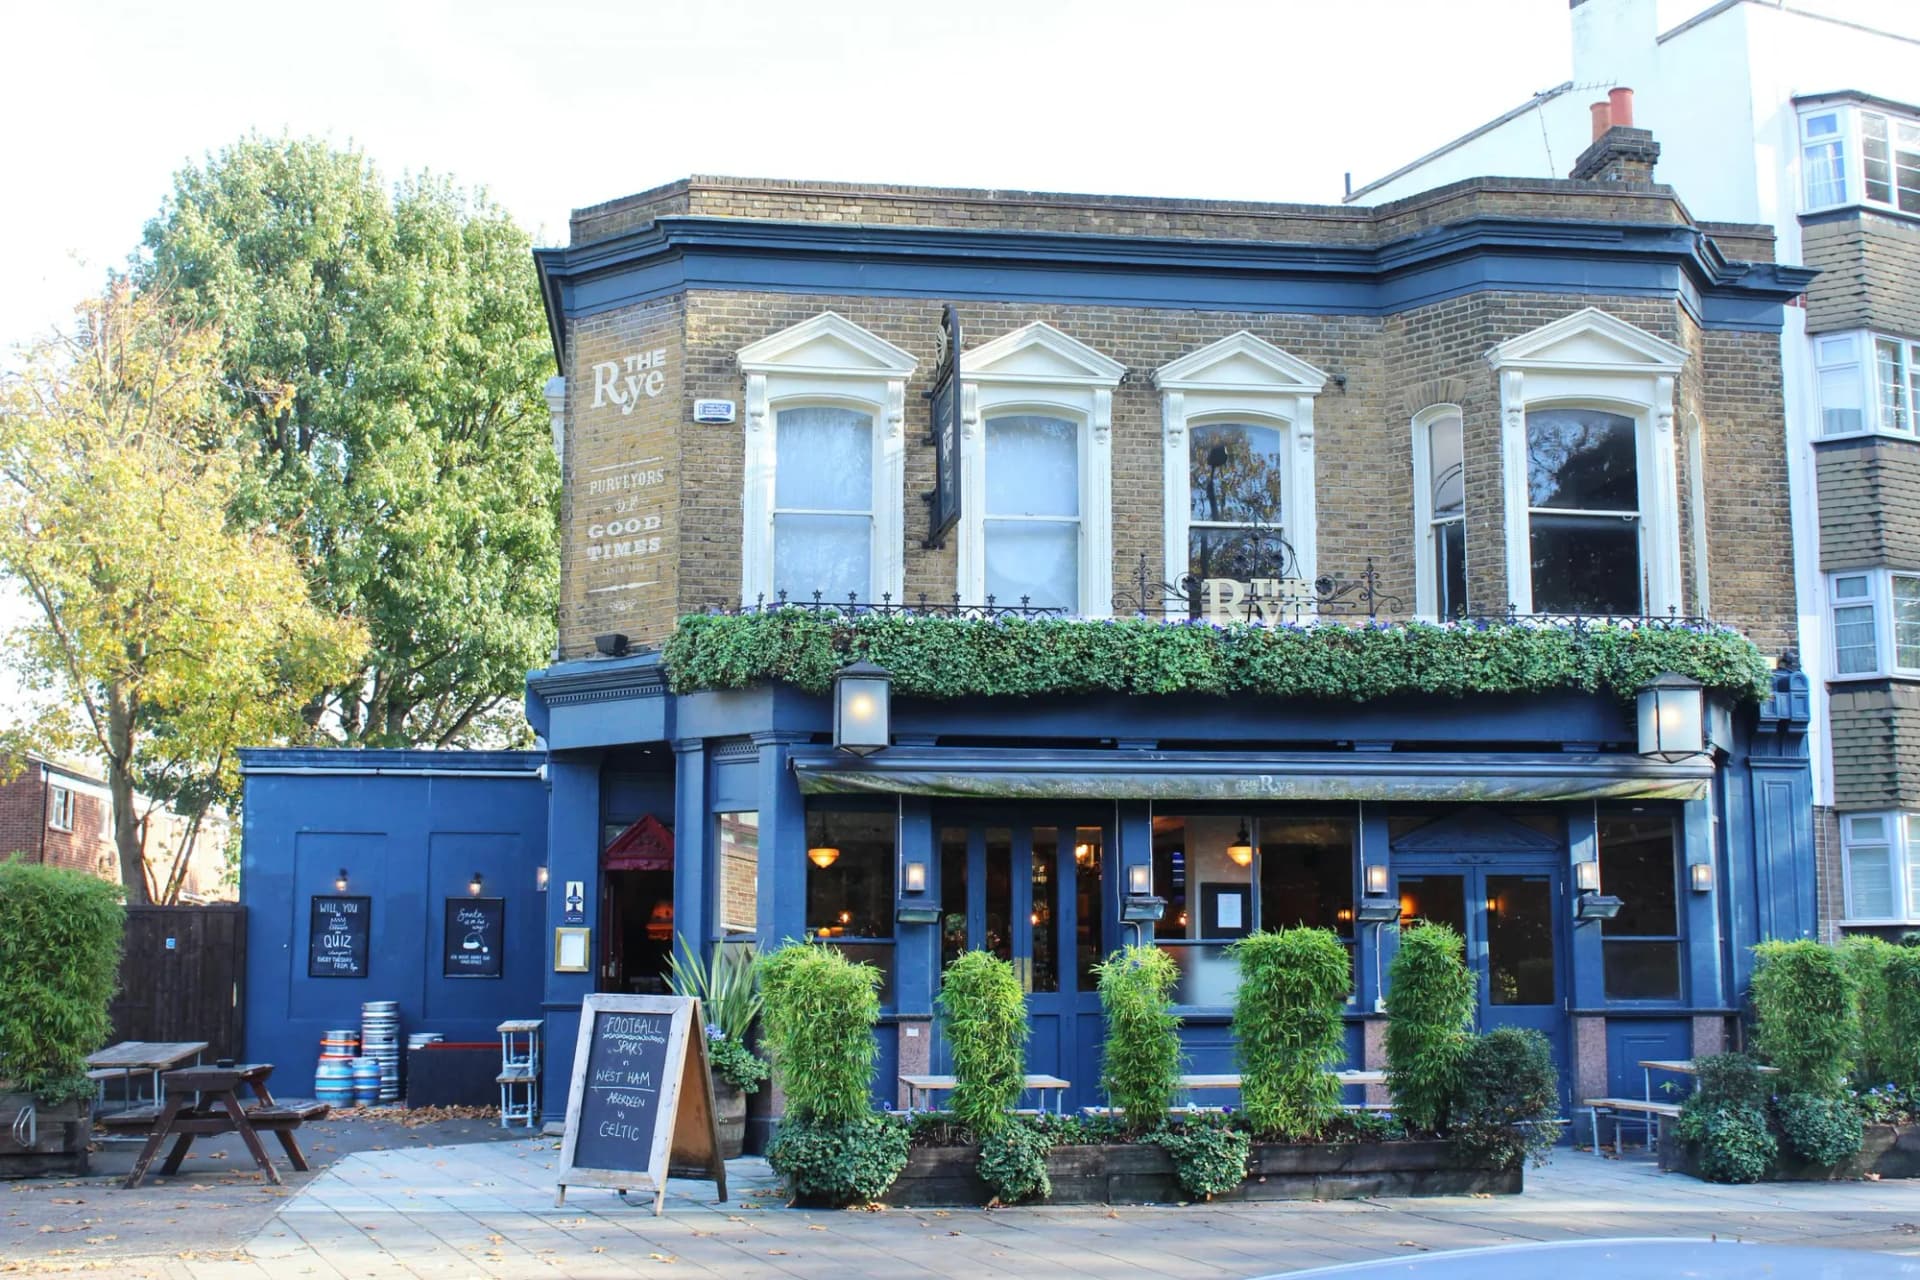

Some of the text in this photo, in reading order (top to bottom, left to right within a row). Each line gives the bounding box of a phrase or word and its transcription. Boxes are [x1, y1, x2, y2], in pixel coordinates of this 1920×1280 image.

[624, 349, 667, 373] THE
[591, 361, 665, 415] Rye
[589, 468, 665, 495] PURVEYORS
[615, 495, 640, 513] OF
[588, 516, 661, 538] GOOD
[587, 537, 661, 561] TIMES
[1250, 578, 1314, 597] THE
[320, 903, 358, 913] WILL YOU
[323, 934, 353, 949] QUIZ
[605, 1016, 663, 1034] FOOTBALL
[596, 1068, 651, 1087] WEST HAM
[606, 1092, 646, 1107] ABERDEEN
[599, 1120, 640, 1141] CELTIC
